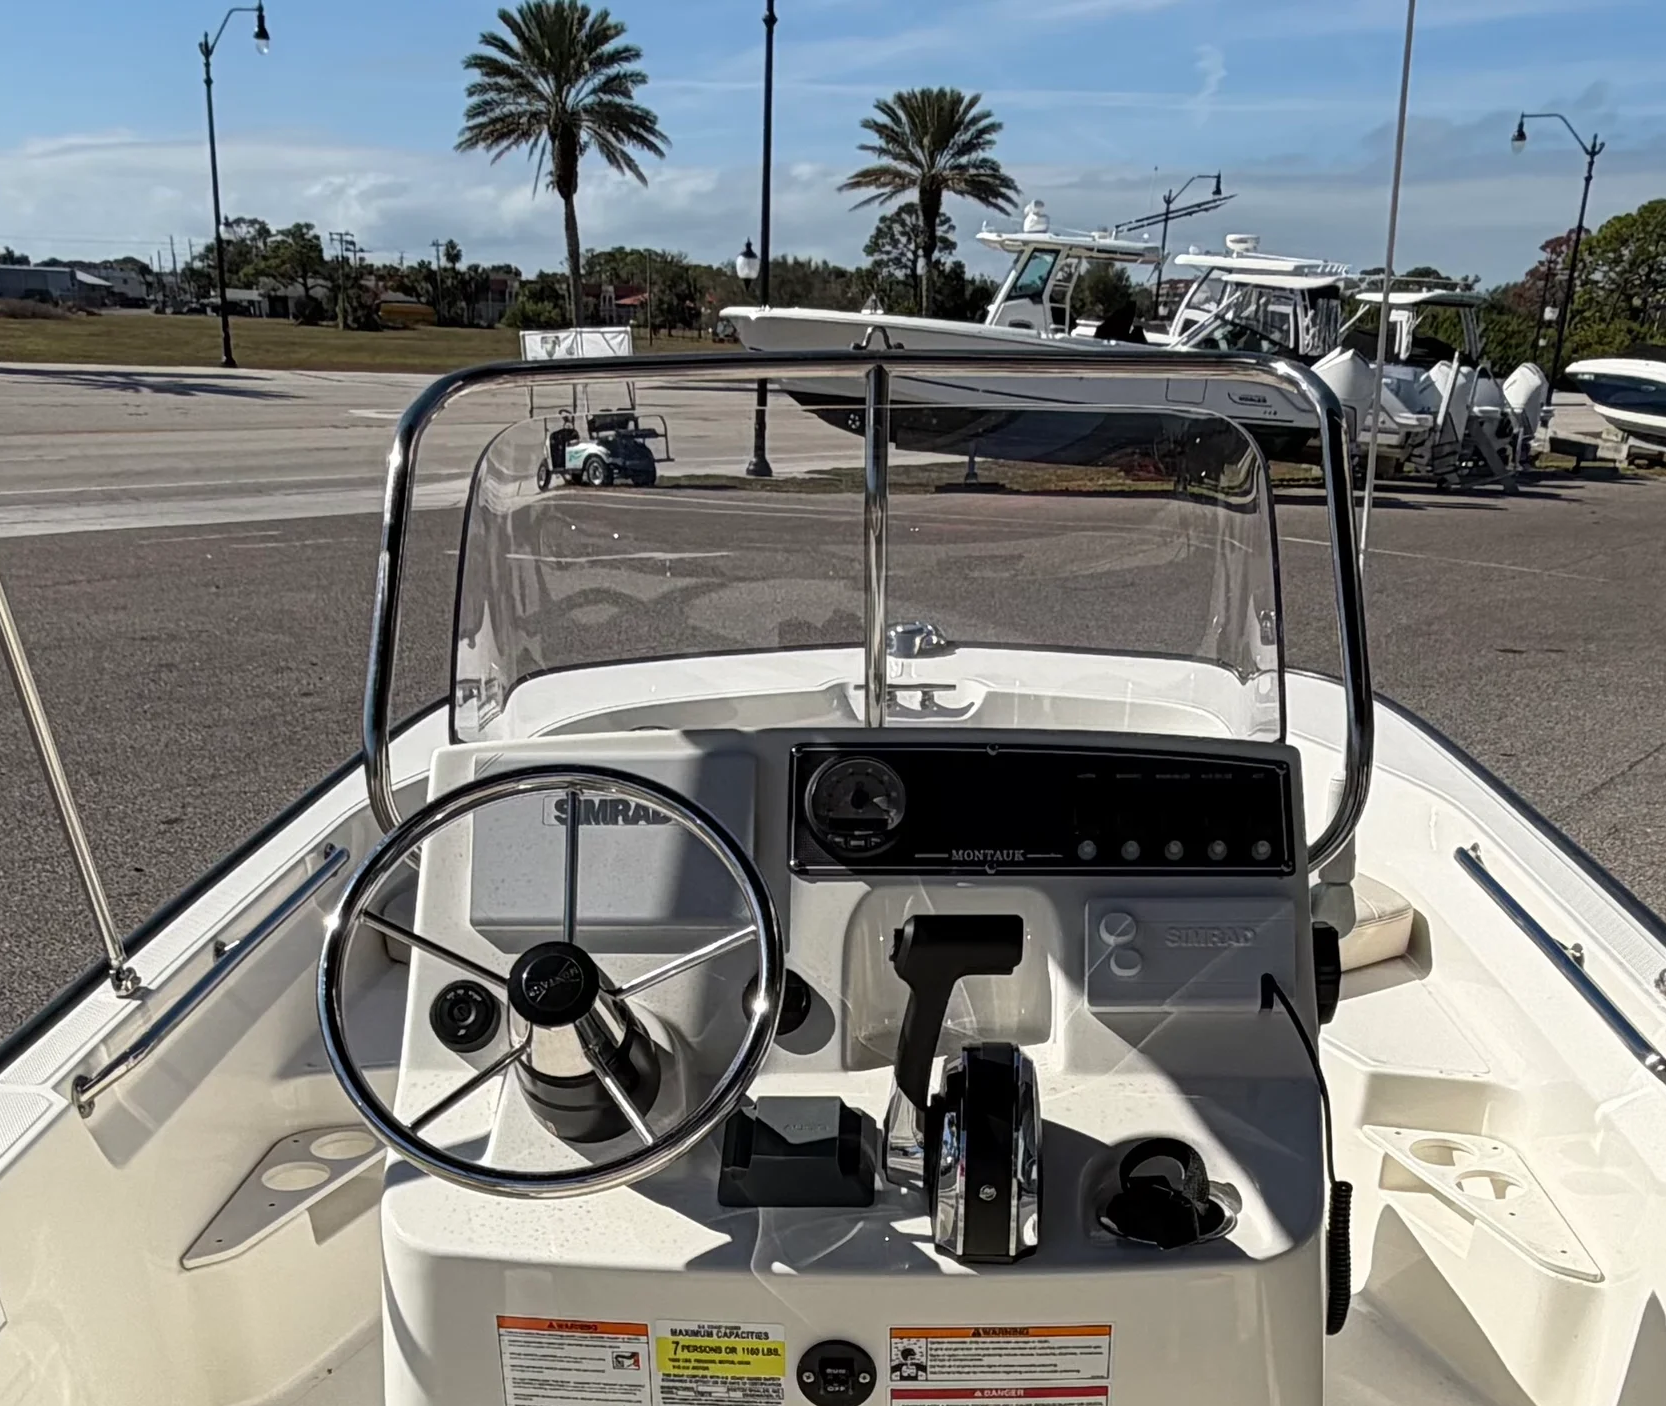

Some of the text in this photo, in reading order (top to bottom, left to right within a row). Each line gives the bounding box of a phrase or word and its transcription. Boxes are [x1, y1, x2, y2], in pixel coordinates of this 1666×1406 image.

[951, 849, 1025, 861] MONTAUK
[670, 1328, 770, 1340] MAXIMUM CAPACITIES
[981, 1327, 1030, 1336] WARNING
[671, 1340, 680, 1356] 7
[681, 1344, 723, 1354] PERSONS
[724, 1346, 738, 1355] OR
[983, 1389, 1025, 1397] DANGER
